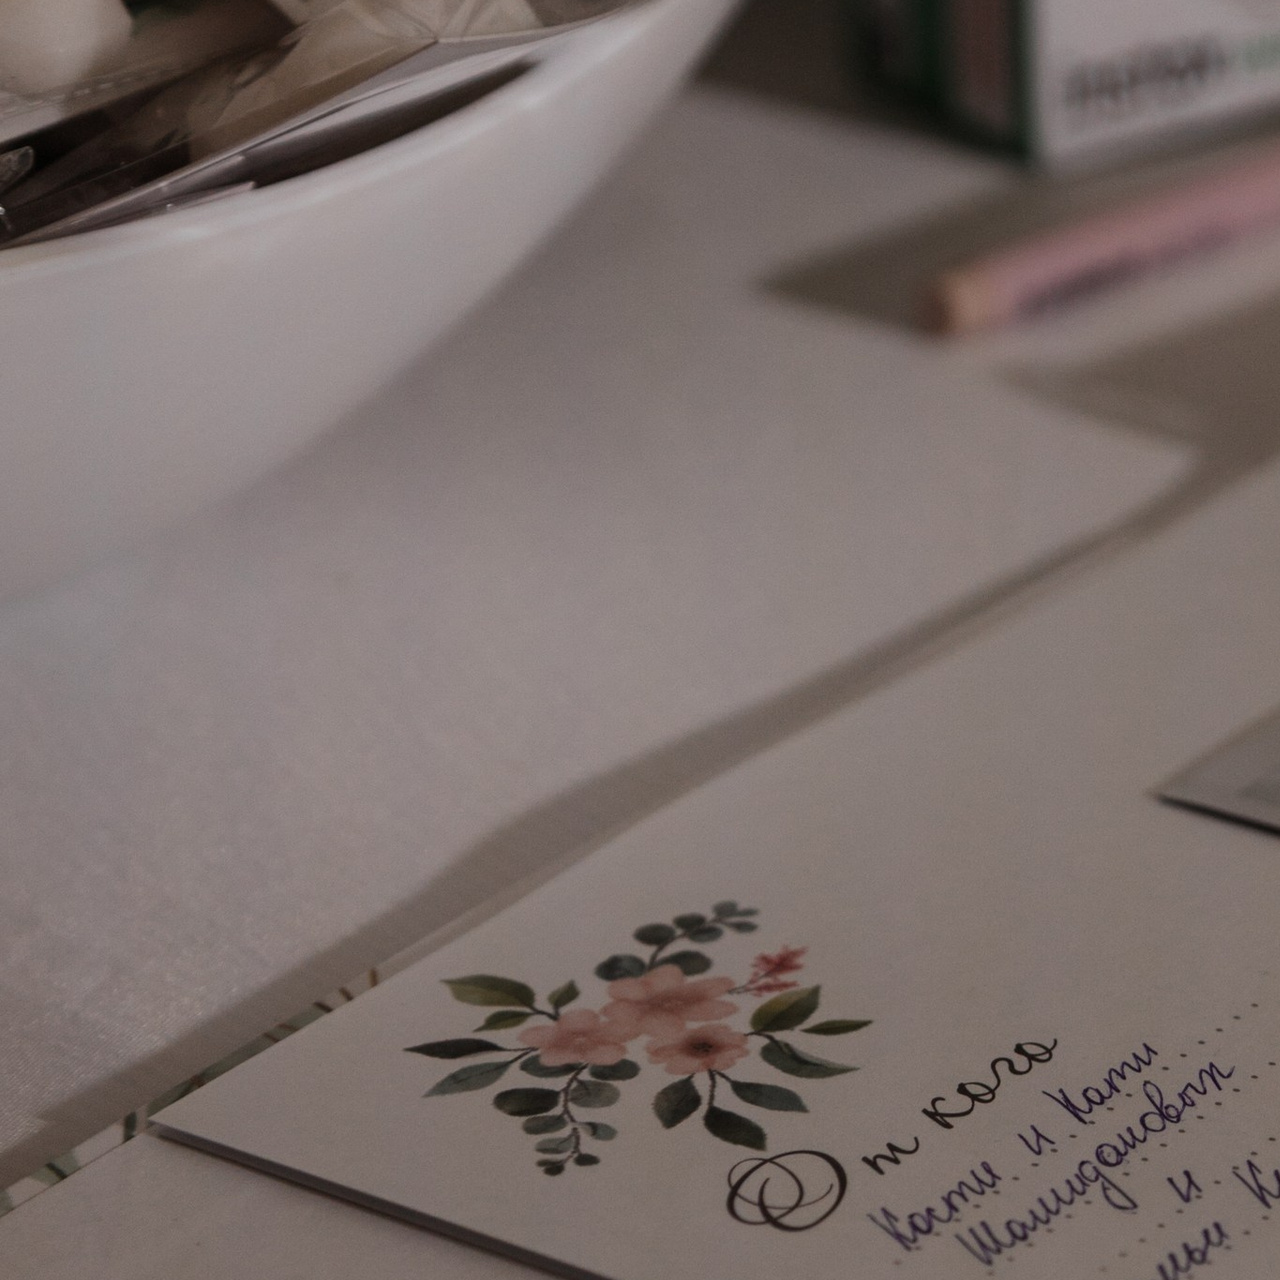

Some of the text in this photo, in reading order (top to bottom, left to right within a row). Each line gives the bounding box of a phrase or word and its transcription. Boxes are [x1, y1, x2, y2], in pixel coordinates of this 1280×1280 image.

[727, 1039, 1058, 1232] От кого
[1018, 1125, 1056, 1156] и
[1042, 1043, 1158, 1124] Кати
[1166, 1170, 1203, 1203] и
